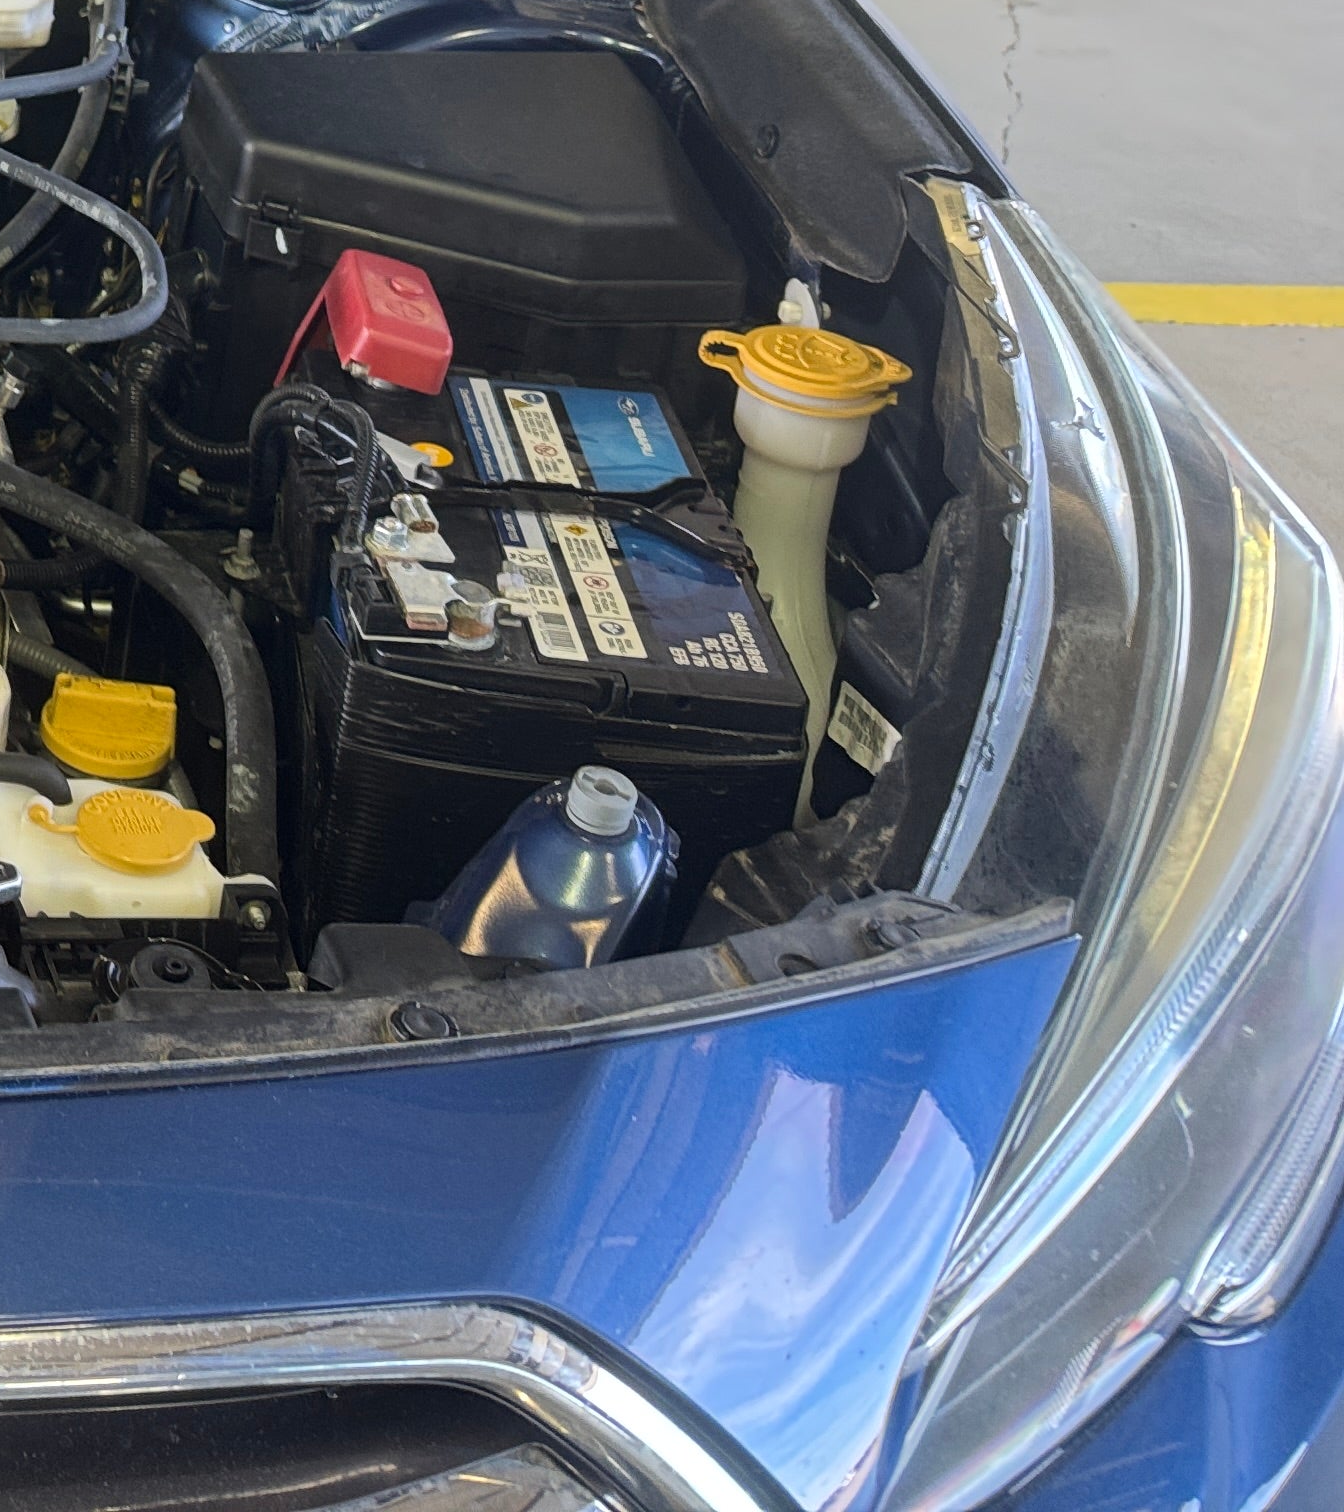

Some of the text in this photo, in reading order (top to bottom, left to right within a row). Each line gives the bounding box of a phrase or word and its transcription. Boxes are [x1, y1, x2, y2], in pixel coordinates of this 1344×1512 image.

[628, 416, 656, 458] SUBARU
[702, 637, 729, 669] RC 120
[719, 632, 749, 671] CCA 750
